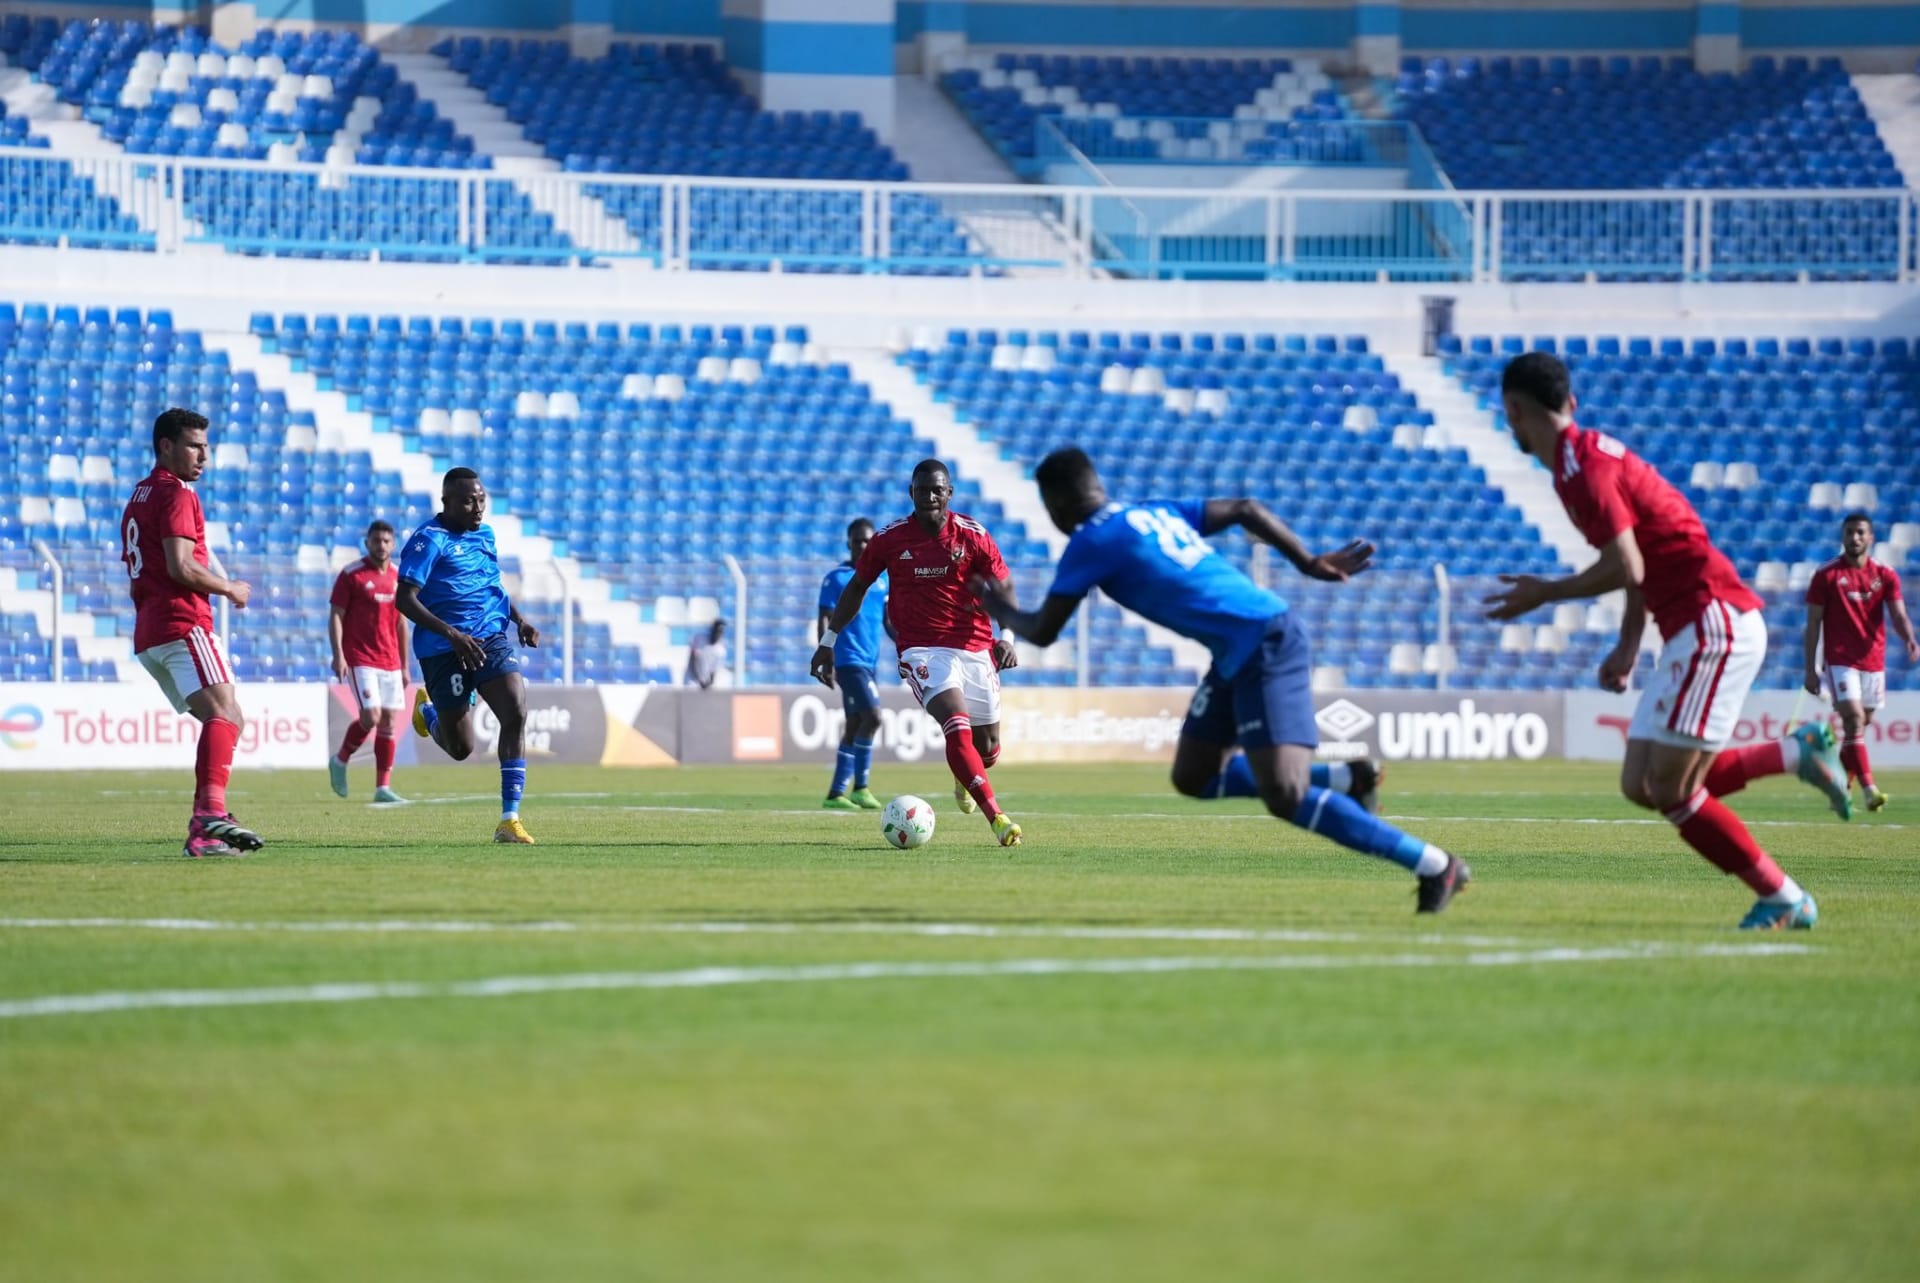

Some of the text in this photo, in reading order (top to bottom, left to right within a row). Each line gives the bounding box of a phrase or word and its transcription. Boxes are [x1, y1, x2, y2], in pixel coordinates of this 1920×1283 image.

[451, 673, 464, 697] 8
[53, 709, 312, 753] TotalEngies
[788, 693, 948, 761] Ornge
[1378, 698, 1549, 760] umbro
